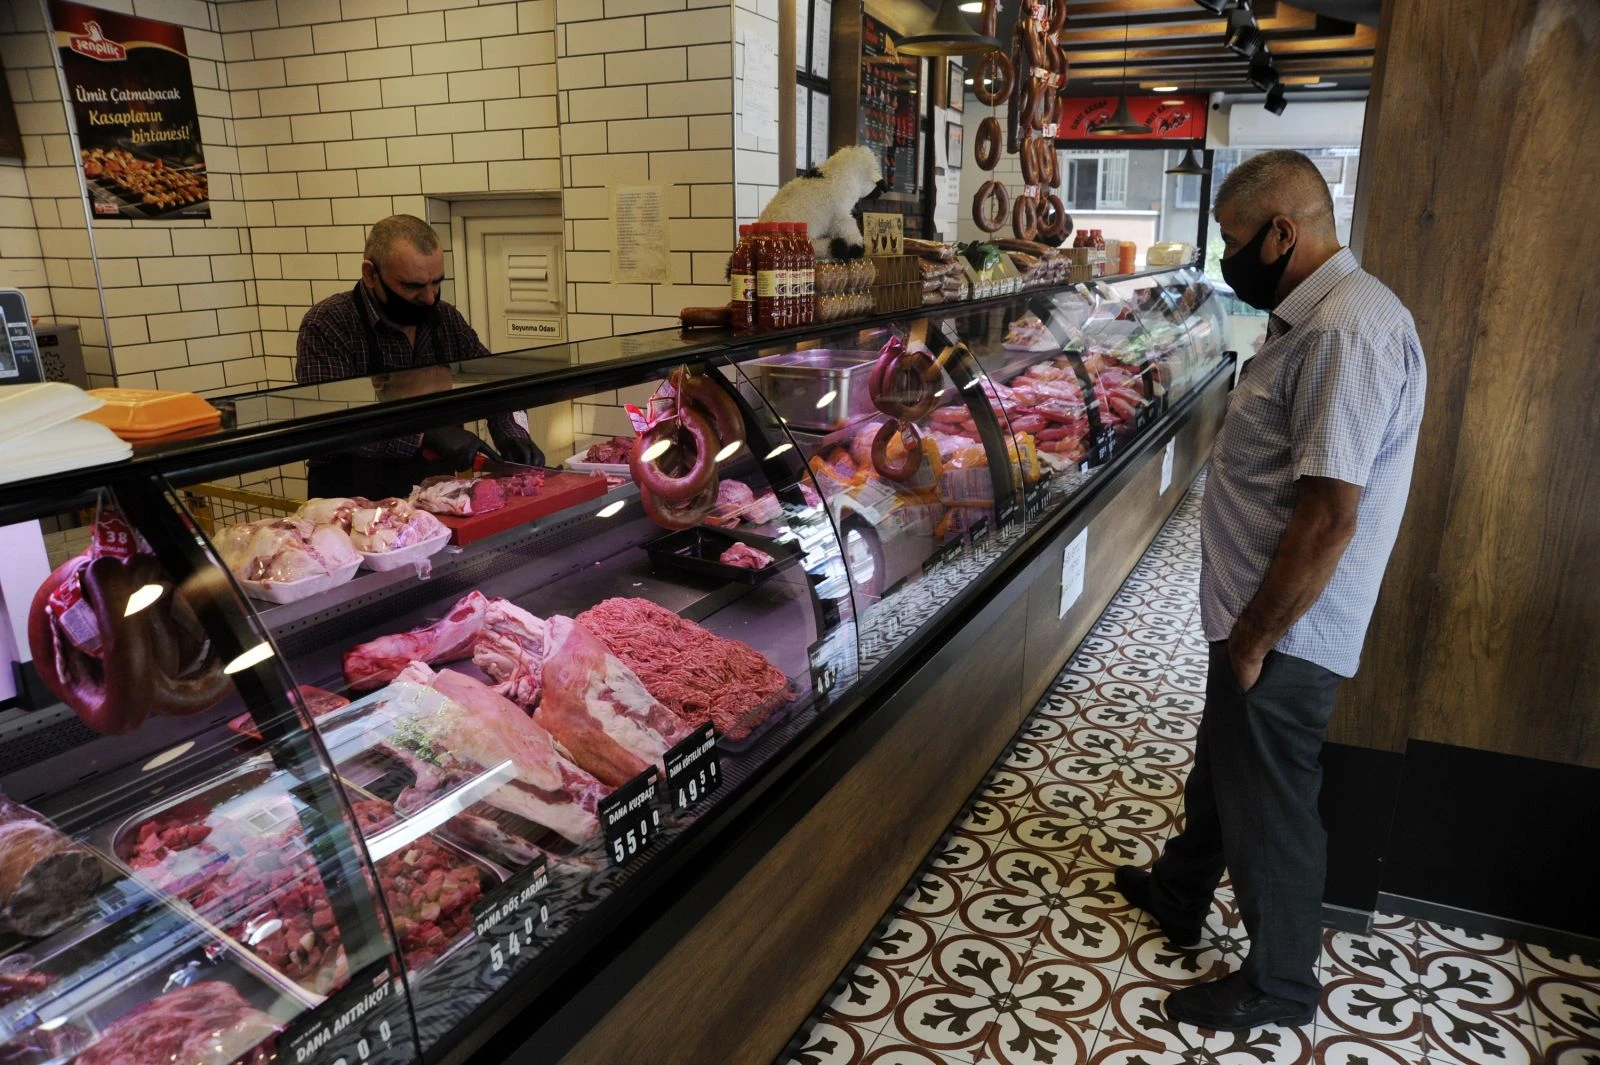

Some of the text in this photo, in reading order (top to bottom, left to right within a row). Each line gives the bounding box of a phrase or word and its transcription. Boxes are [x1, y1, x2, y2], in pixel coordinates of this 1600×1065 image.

[76, 85, 181, 104] Ümit Çatmabacak
[89, 110, 163, 126] Kasapların
[131, 126, 190, 143] birtanesi!
[511, 323, 556, 332] Soyunma Odası
[106, 531, 128, 544] 38
[670, 762, 682, 778] DANA
[609, 805, 628, 825] DANA
[629, 785, 655, 811] KUŞBAŞI
[477, 910, 501, 936] DANA
[503, 896, 519, 916] DÖŞ
[521, 875, 548, 903] SARMA
[296, 1027, 331, 1062] DANA
[334, 982, 390, 1035] ANTRİKOT
